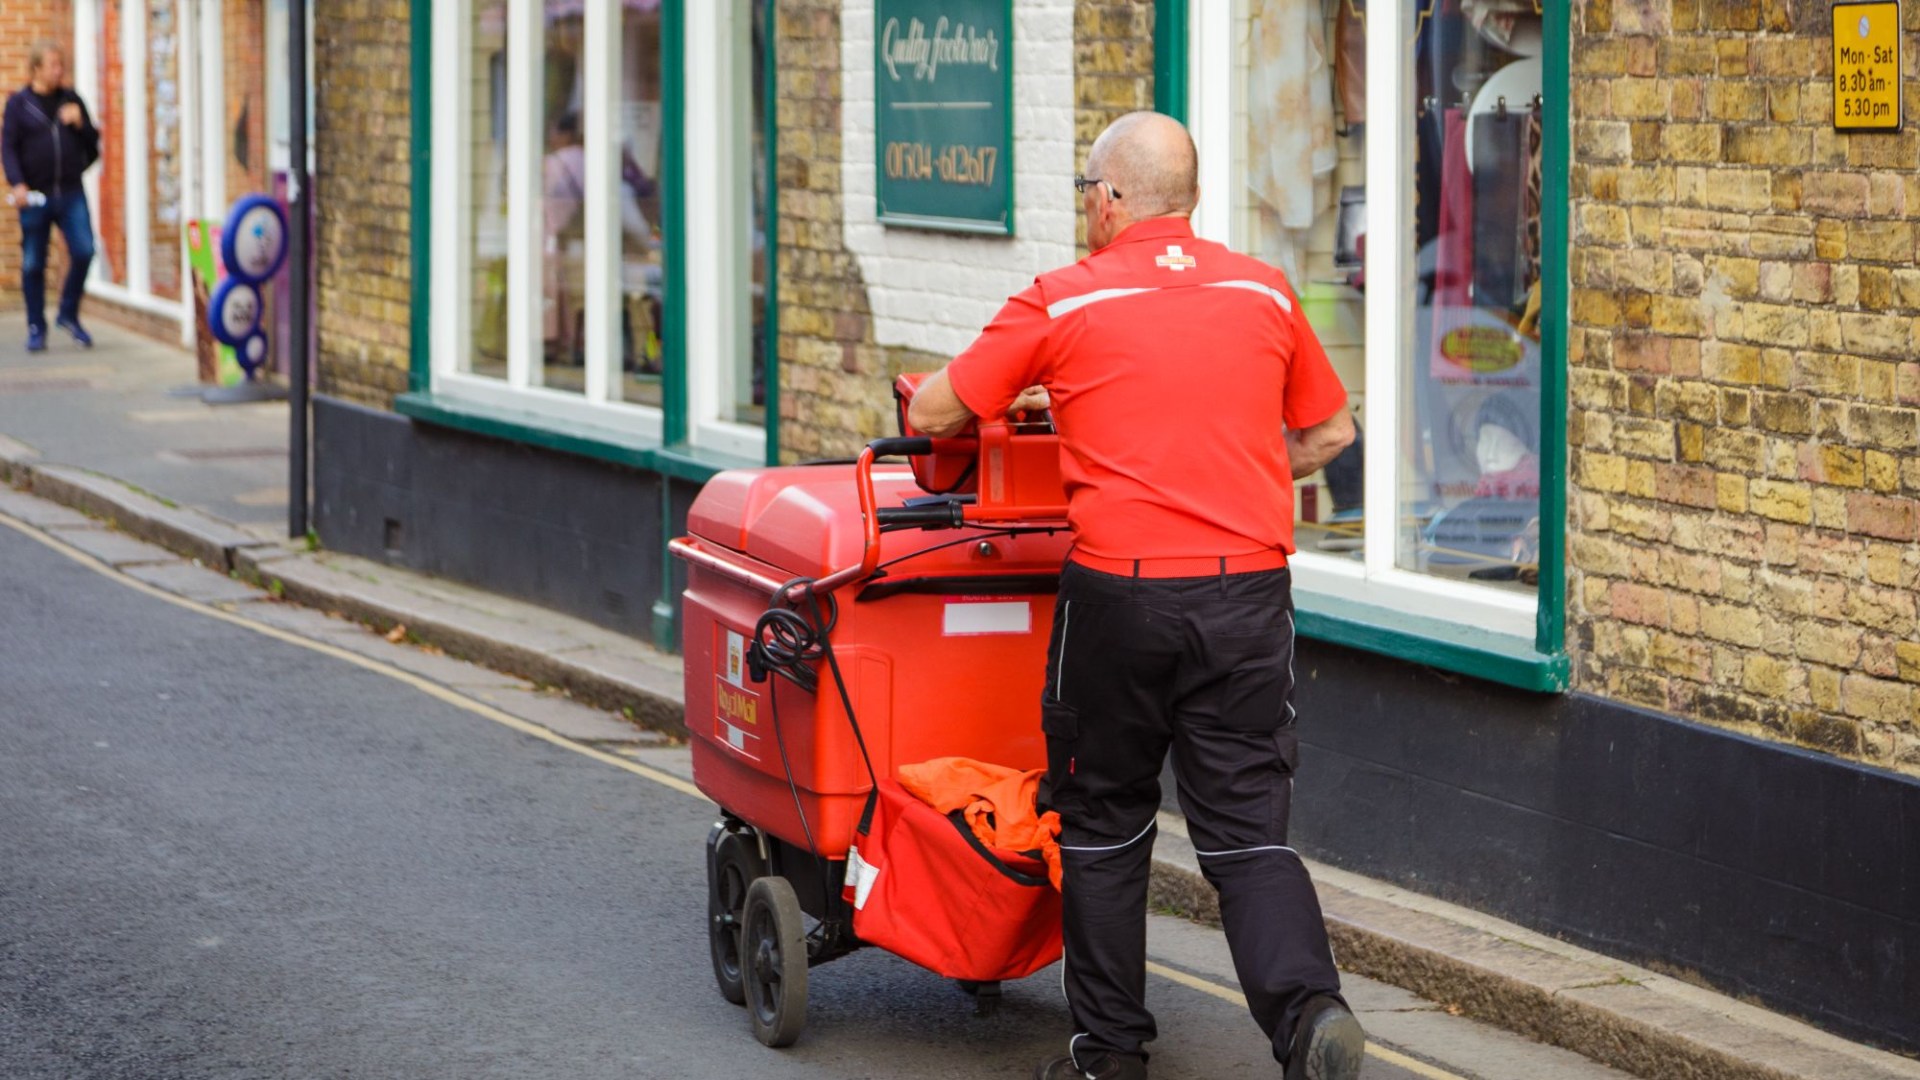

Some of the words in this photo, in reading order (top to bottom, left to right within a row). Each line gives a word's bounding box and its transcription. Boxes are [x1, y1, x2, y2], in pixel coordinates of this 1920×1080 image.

[1840, 47, 1865, 64] Mon
[1873, 45, 1893, 64] Sat
[1839, 72, 1867, 92] 8.30
[1868, 76, 1886, 92] am
[1844, 97, 1871, 117] 5.30
[1873, 101, 1890, 119] pm
